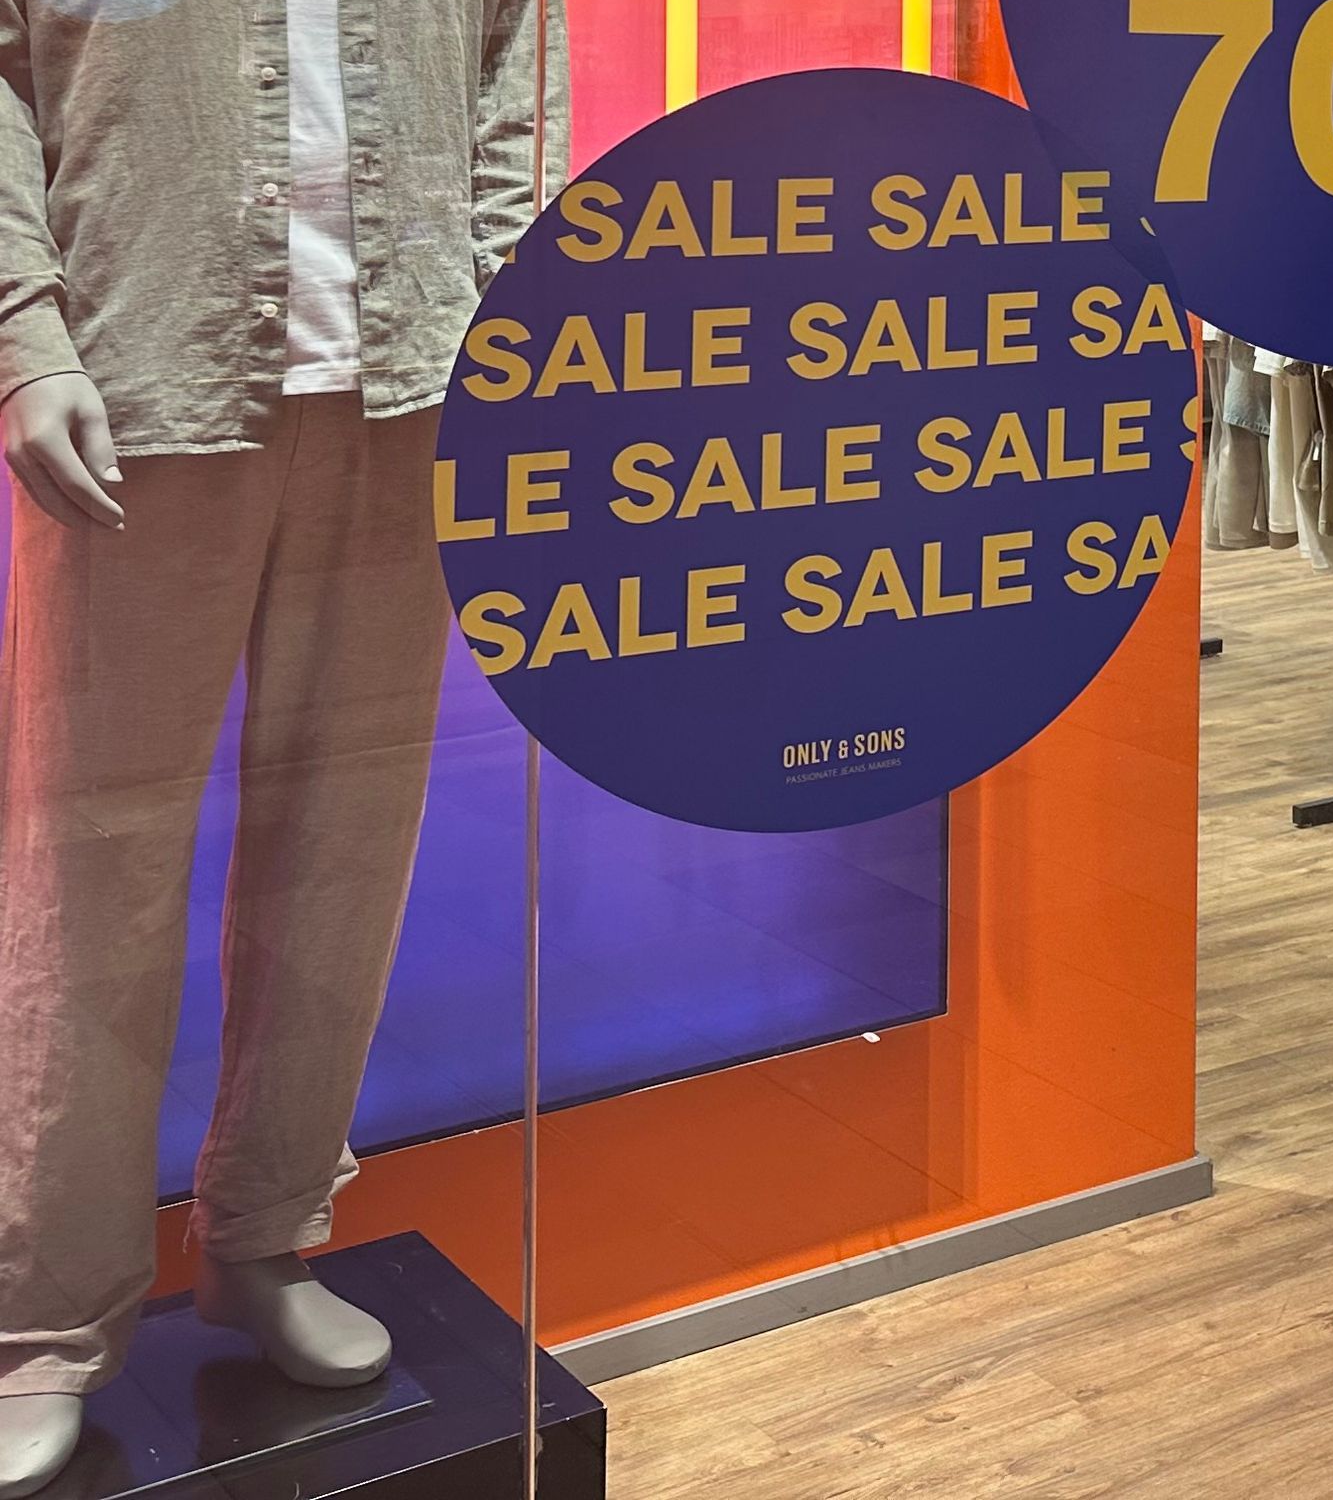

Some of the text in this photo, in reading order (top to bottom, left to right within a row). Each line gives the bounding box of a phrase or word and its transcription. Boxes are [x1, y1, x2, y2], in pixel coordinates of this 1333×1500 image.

[556, 171, 1110, 262] SALE SALE
[461, 307, 751, 402] SALE
[786, 292, 1039, 380] SALE
[608, 423, 882, 524] SALE
[914, 400, 1152, 493] SALE
[459, 564, 747, 677] SALE
[781, 530, 1034, 634] SALE
[783, 727, 906, 768] ONLY & SONS
[786, 757, 902, 785] PASSIONATE JEANS MAKERS
